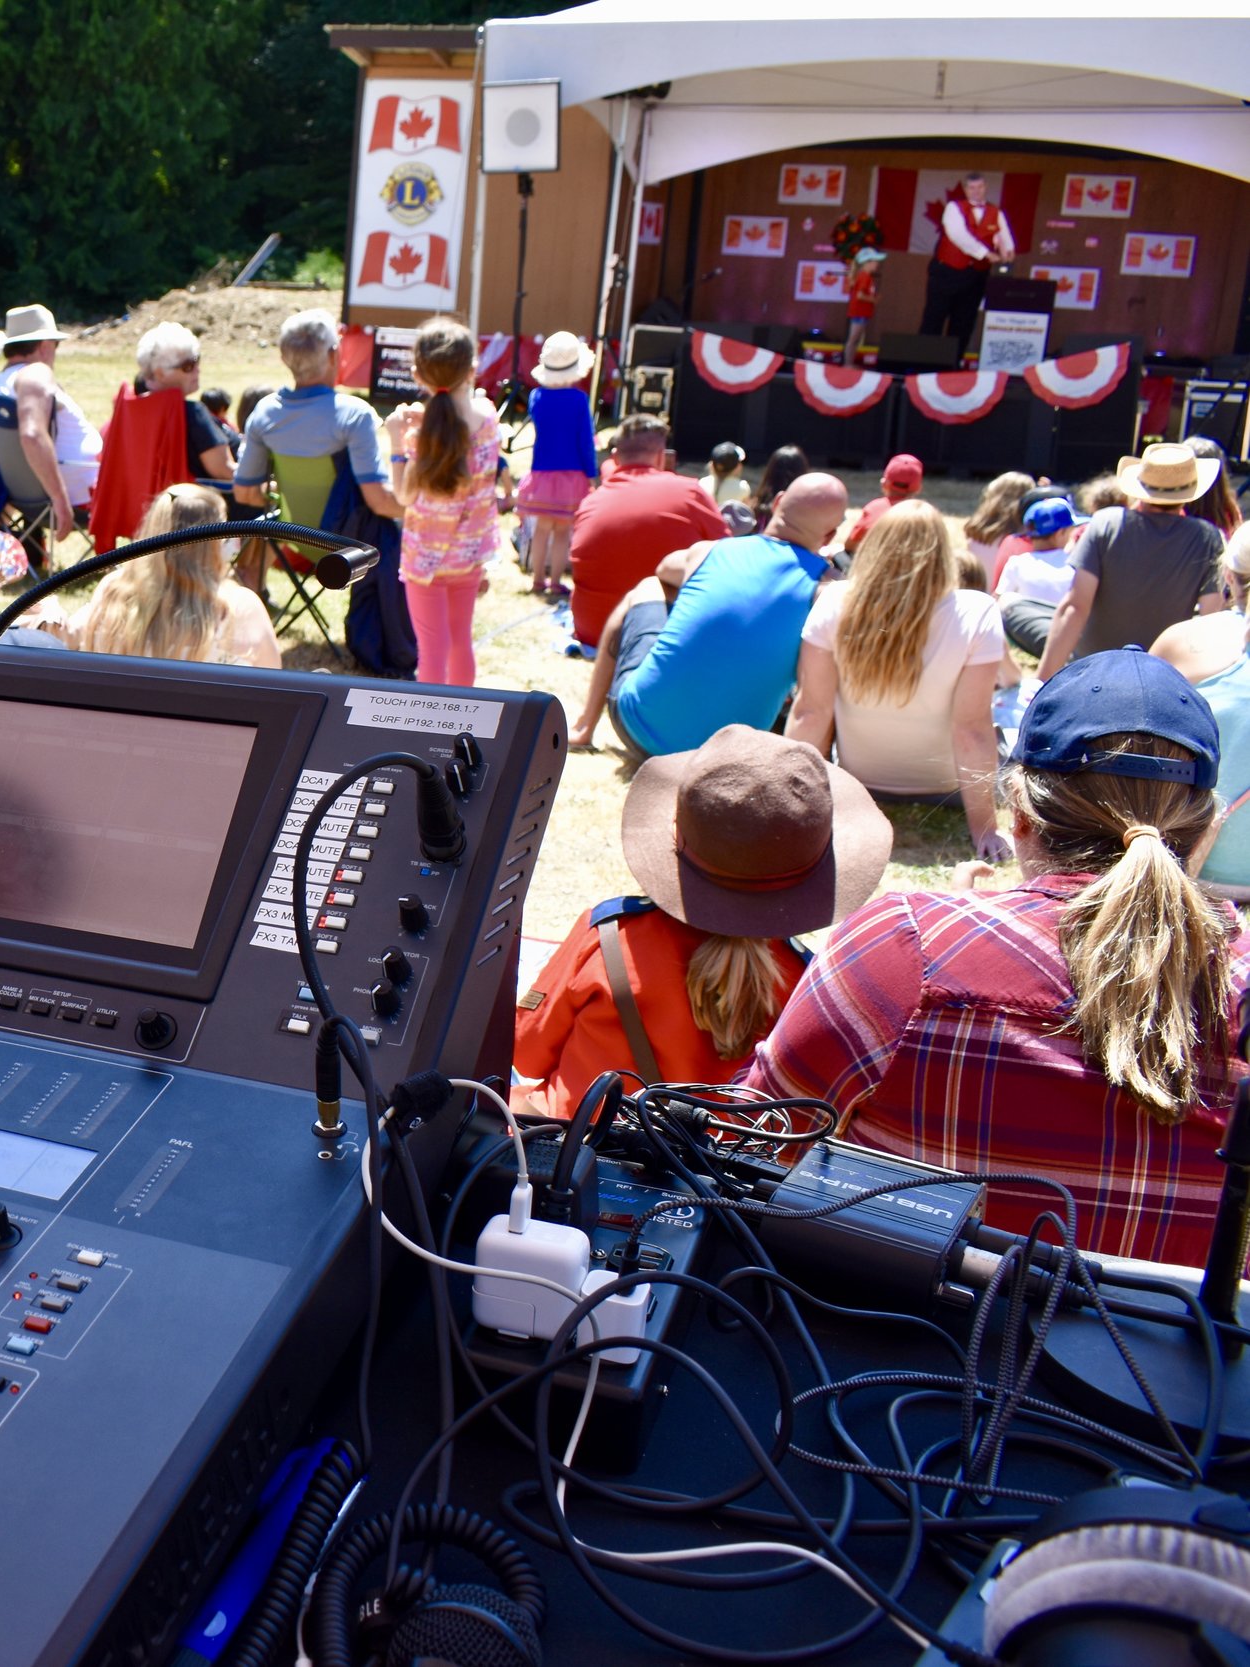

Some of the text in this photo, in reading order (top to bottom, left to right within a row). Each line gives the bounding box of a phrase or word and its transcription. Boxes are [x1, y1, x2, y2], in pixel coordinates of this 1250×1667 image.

[404, 180, 421, 205] L
[369, 696, 480, 714] TOUCH IP192.168.1.7
[371, 714, 473, 731] SURF IP192.168.1.8
[429, 746, 454, 754] SCREEN
[301, 775, 329, 785] DCA1
[294, 796, 319, 807] DCA
[319, 823, 350, 834] MUTE
[310, 845, 342, 856] MUTE
[307, 867, 332, 878] UTE
[266, 884, 288, 895] FX2
[257, 908, 278, 919] FX3
[255, 932, 277, 943] FX3
[0, 990, 23, 999] COLOUR
[1, 985, 19, 993] NAME
[52, 990, 72, 998] SETUP
[39, 997, 56, 1005] RACK
[61, 1001, 88, 1011] SURFACE
[96, 1007, 118, 1016] UTILITY
[362, 1025, 383, 1033] MONO
[168, 1138, 194, 1149] PAFL
[799, 1169, 840, 1188] Pre
[616, 1183, 689, 1201] RFI Surge
[896, 1197, 954, 1220] USB
[19, 1216, 38, 1224] MUTE
[51, 1268, 79, 1279] OUTPUT
[38, 1288, 60, 1299] INPUT
[24, 1310, 62, 1324] CLEAR ALL
